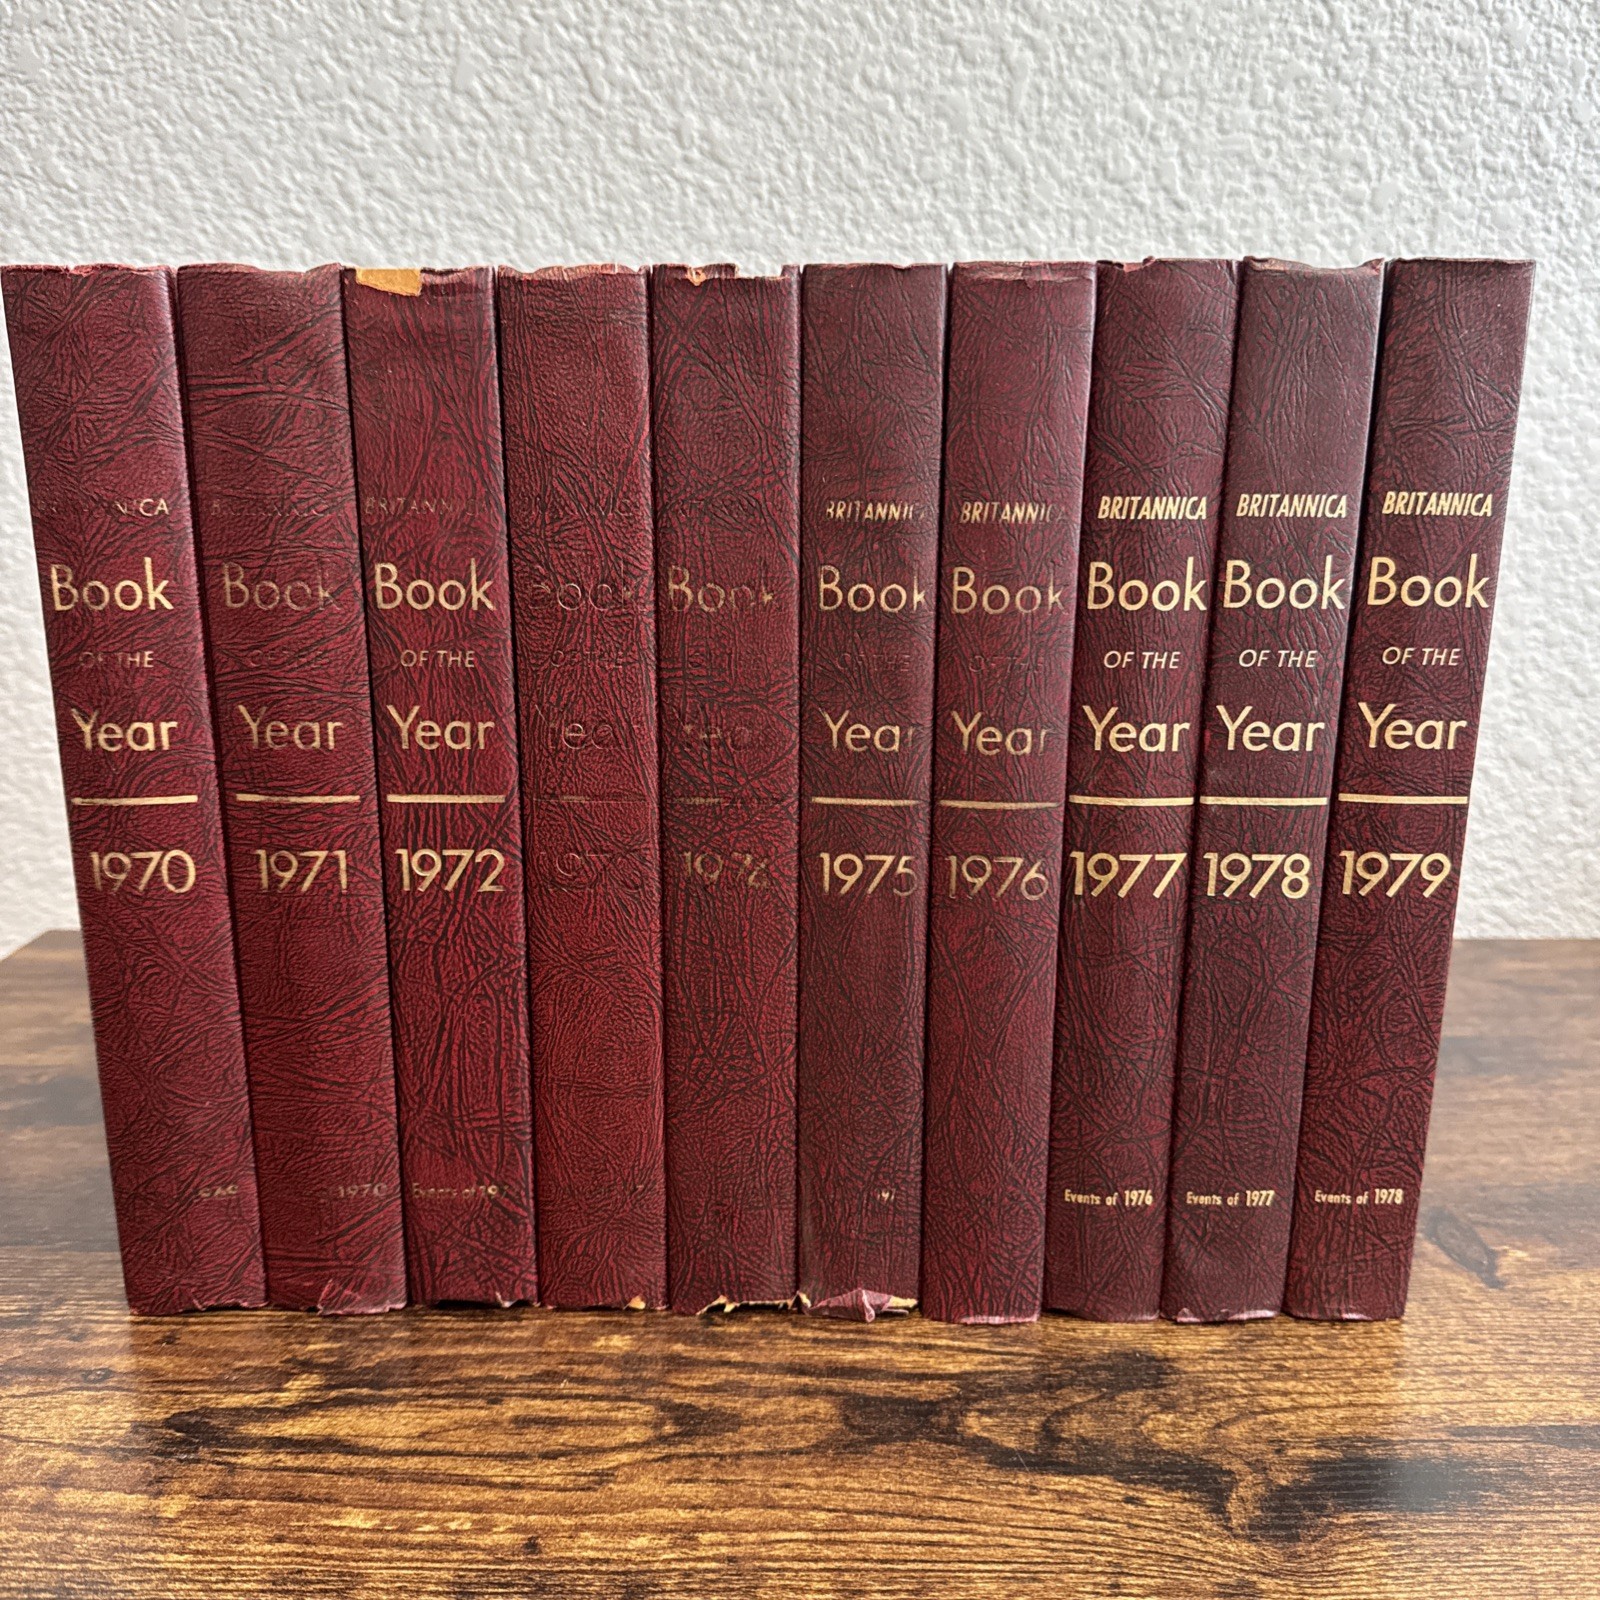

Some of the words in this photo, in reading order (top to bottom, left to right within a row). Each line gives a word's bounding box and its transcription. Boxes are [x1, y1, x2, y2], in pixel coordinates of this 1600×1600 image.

[1098, 496, 1207, 520] BRITANNICA
[1236, 493, 1347, 518] BRITANNICA
[1382, 491, 1493, 516] BRITANNICA
[50, 557, 174, 611] Book
[222, 562, 341, 611] Book
[374, 557, 496, 611] Book
[818, 564, 926, 613] Book
[951, 566, 1069, 615] Book
[1087, 556, 1208, 612] Book
[1223, 555, 1346, 610] Book
[1367, 553, 1490, 608] Book
[115, 650, 155, 668] THE
[400, 650, 429, 668] OF
[437, 650, 476, 668] THE
[1103, 650, 1134, 669] OF
[1142, 651, 1181, 670] THE
[1238, 649, 1270, 668] OF
[1277, 650, 1318, 668] THE
[1381, 647, 1413, 666] OF
[1421, 647, 1461, 666] THE
[71, 708, 178, 752] Year
[237, 704, 344, 750] Year
[386, 704, 495, 750] Year
[951, 710, 1054, 757] Year
[1082, 705, 1191, 752] Year
[1216, 704, 1325, 752] Year
[1358, 702, 1467, 750] Year
[90, 850, 197, 894] 1970
[255, 849, 349, 894] 1971
[394, 849, 506, 893] 1972
[819, 852, 919, 897] 1975
[944, 854, 1049, 901] 1976
[1070, 851, 1187, 899] 1977
[1203, 852, 1311, 900] 1978
[1339, 850, 1452, 899] 1979
[1064, 1189, 1101, 1206] Events
[1105, 1193, 1119, 1206] of
[1124, 1190, 1153, 1207] 1976
[1186, 1191, 1222, 1206] Events
[1226, 1193, 1240, 1206] of
[1246, 1190, 1275, 1207] 1977
[1314, 1189, 1351, 1205] Events
[1356, 1191, 1369, 1205] of
[1374, 1188, 1404, 1205] 1978
